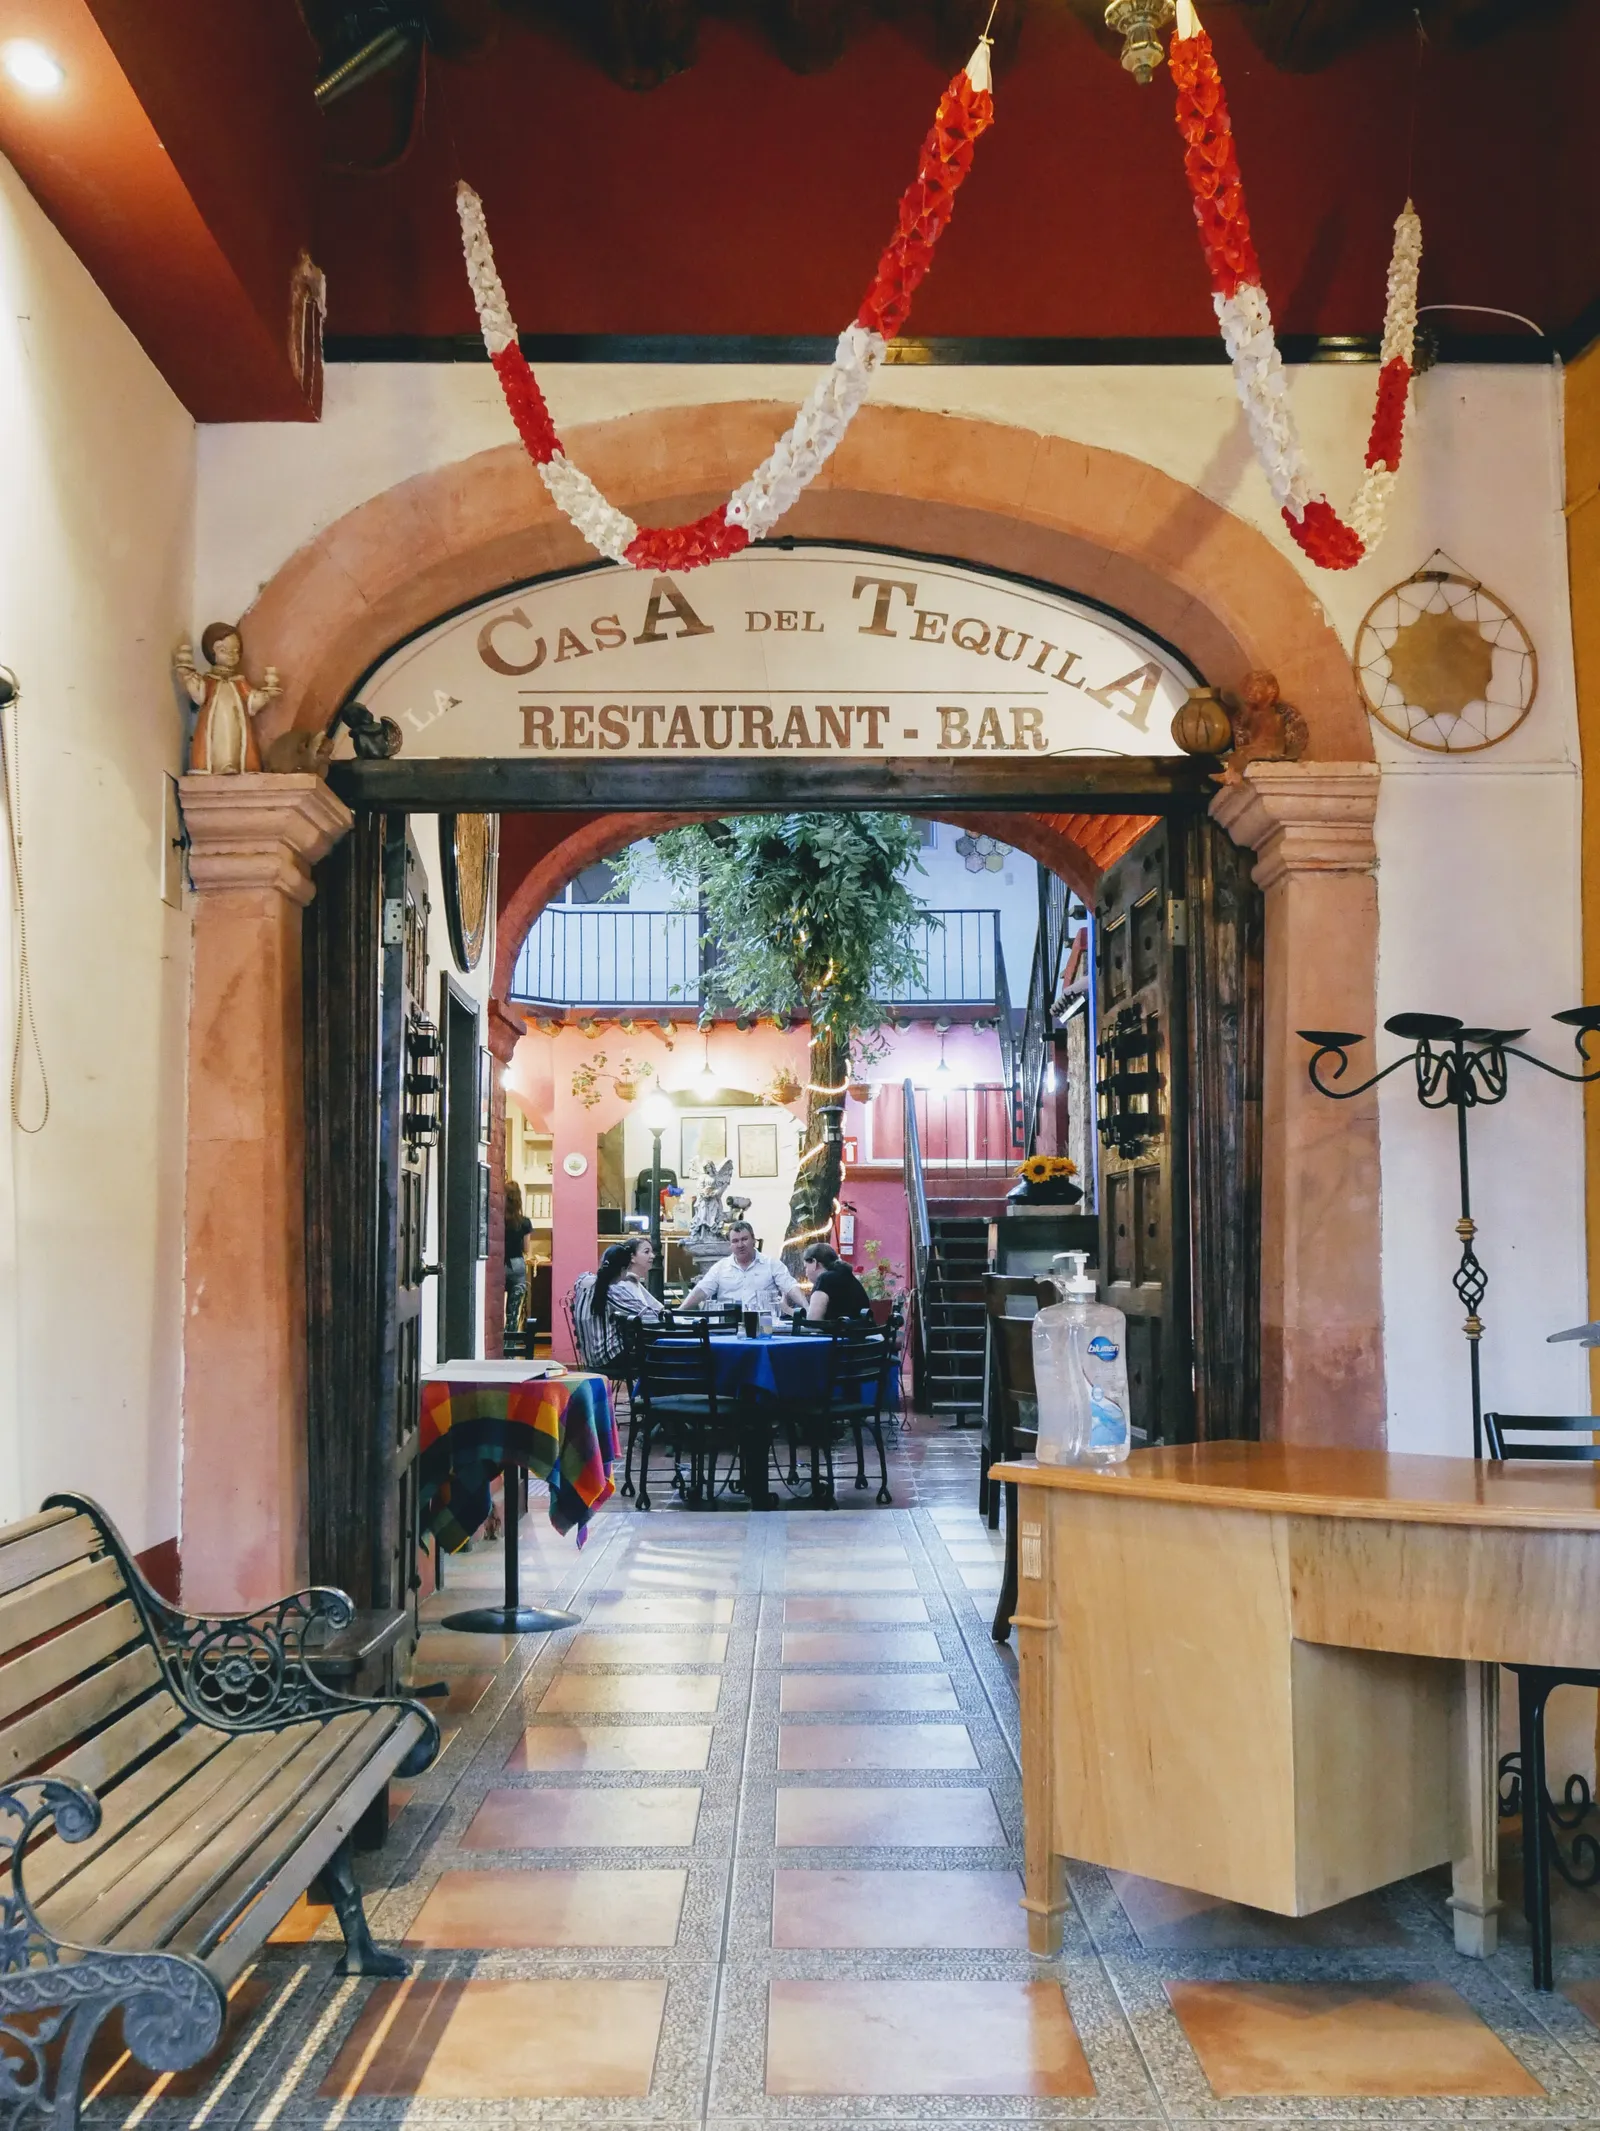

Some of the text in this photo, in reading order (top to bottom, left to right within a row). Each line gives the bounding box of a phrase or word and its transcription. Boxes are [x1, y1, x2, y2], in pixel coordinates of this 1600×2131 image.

[402, 574, 1164, 735] LA CASA DEL TEQUILA
[519, 704, 890, 750] RESTAURANT
[935, 705, 1050, 751] BAR
